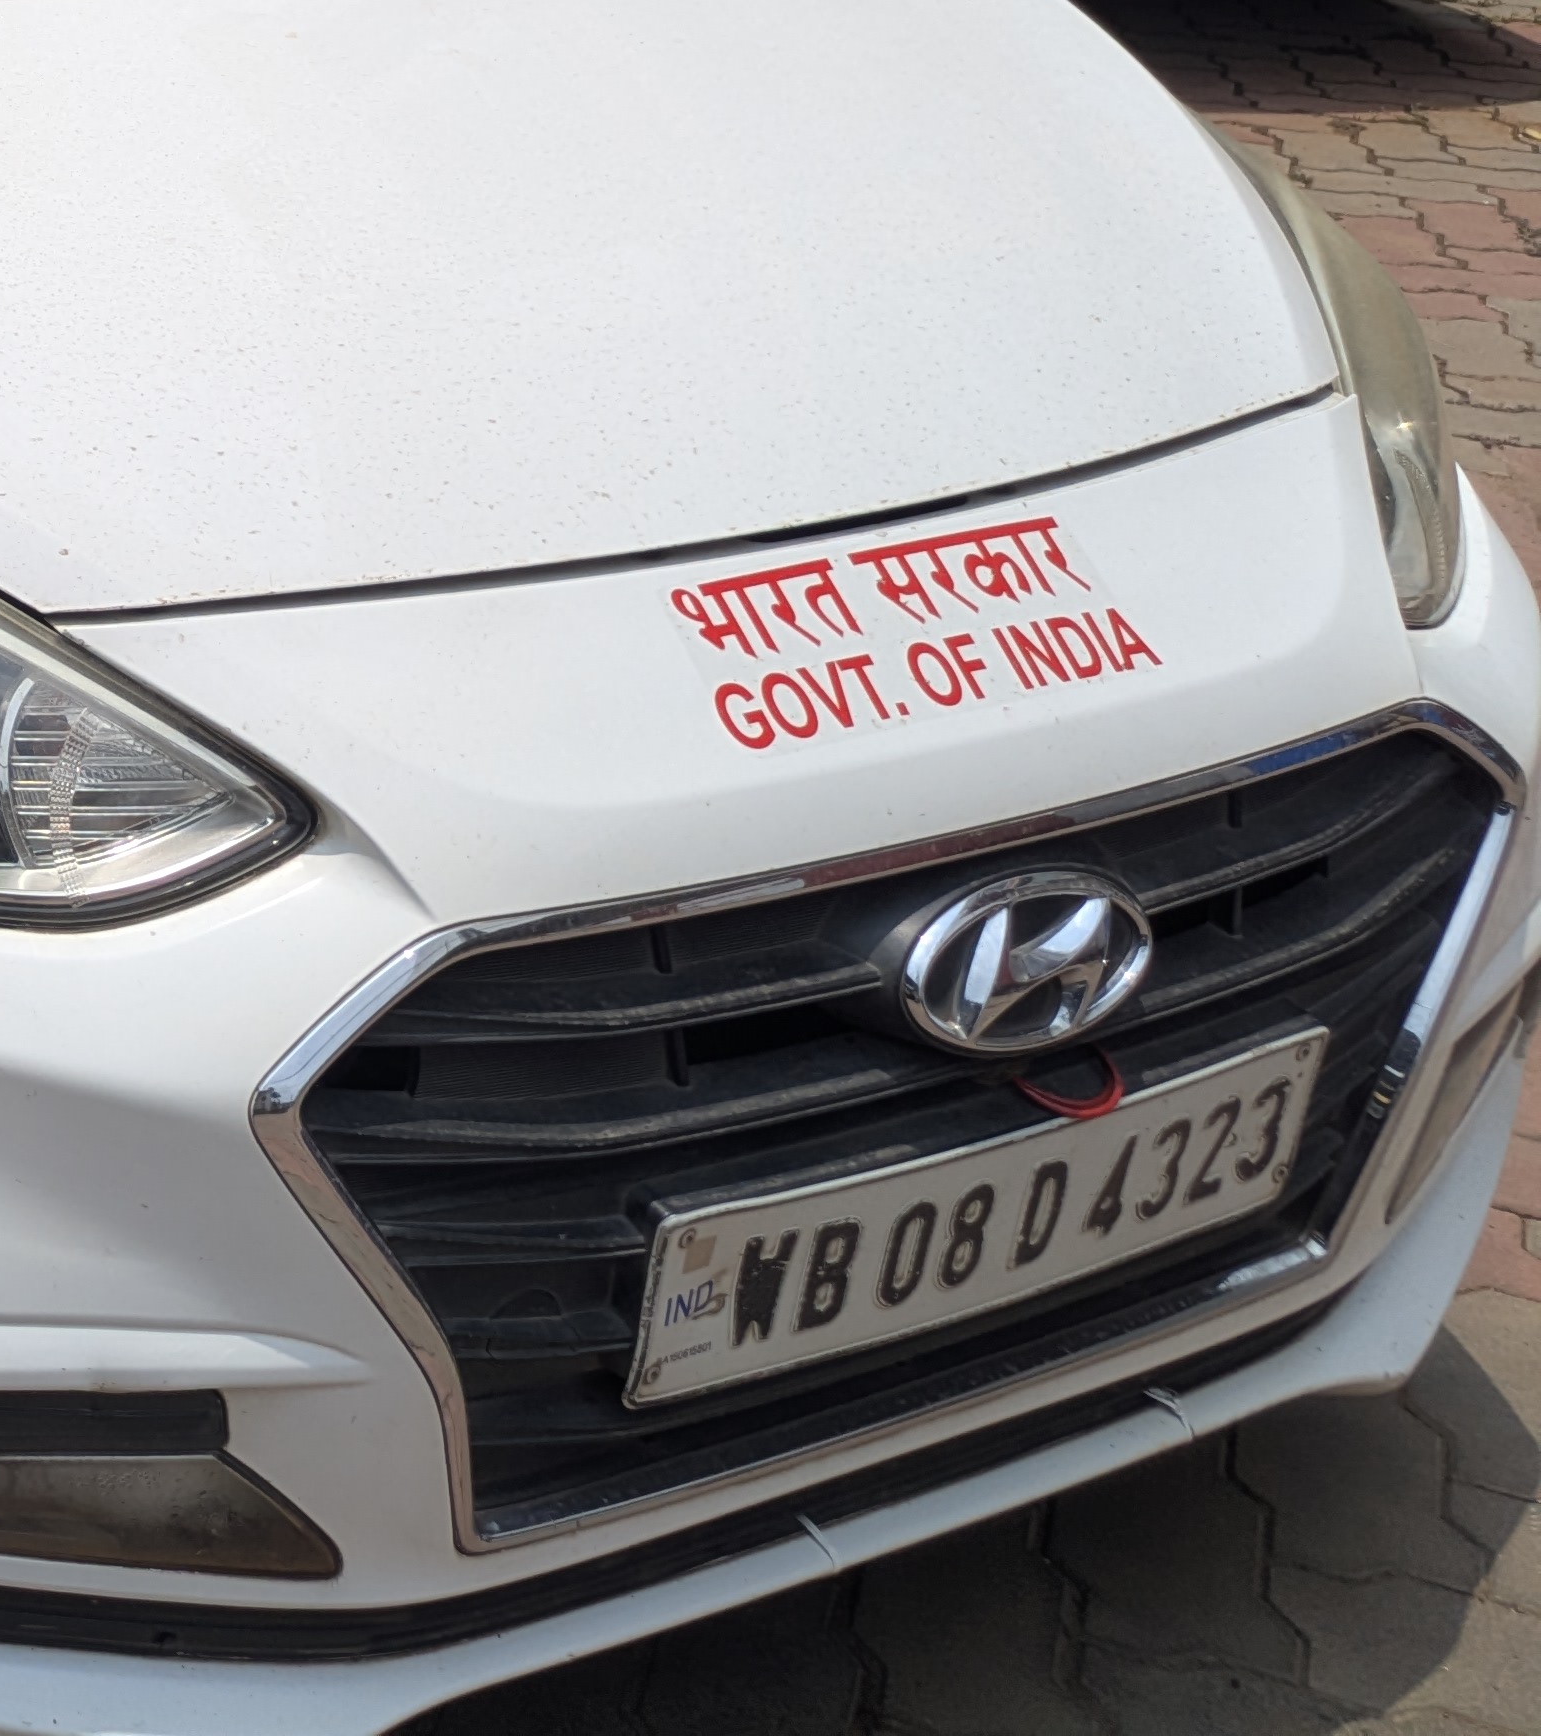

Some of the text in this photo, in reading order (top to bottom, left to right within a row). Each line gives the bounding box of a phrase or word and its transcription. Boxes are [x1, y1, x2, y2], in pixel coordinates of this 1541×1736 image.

[670, 515, 1092, 659] भारत सरकार
[714, 607, 1164, 750] GOVT. OF INDIA
[664, 1279, 715, 1327] IND
[732, 1214, 864, 1347] WB
